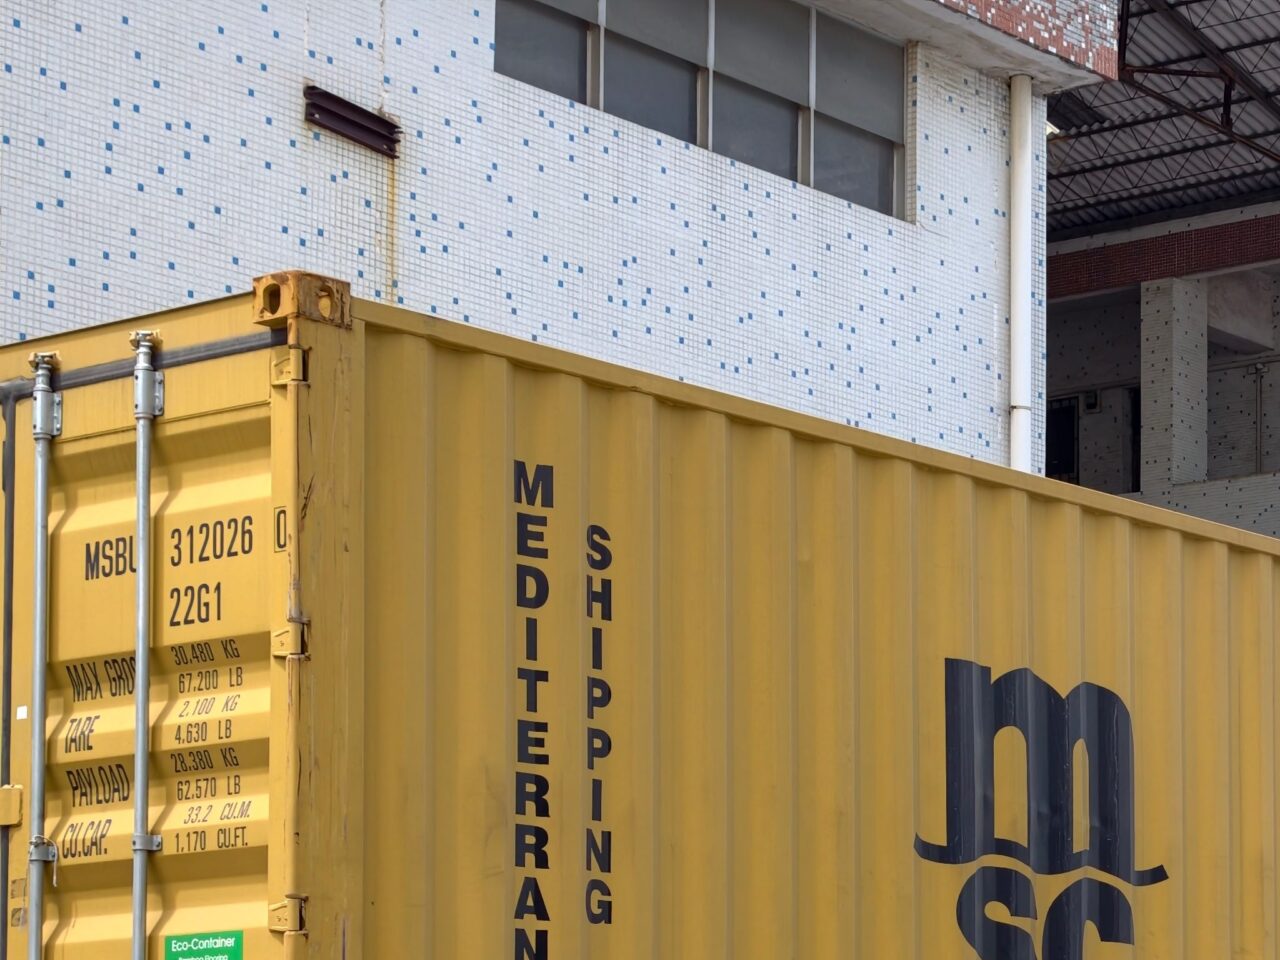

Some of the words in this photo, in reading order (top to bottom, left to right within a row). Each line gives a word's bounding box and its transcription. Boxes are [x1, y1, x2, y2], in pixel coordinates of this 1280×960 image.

[170, 515, 254, 567] 312026
[276, 509, 287, 549] 0
[169, 582, 221, 627] 22G1
[221, 639, 241, 660] KG
[66, 662, 103, 703] MAX
[104, 655, 136, 697] GRO
[229, 666, 243, 687] LB
[221, 694, 240, 713] KG
[65, 715, 100, 754] TARE
[218, 719, 232, 740] LB
[585, 524, 613, 925] SHIPPING
[220, 747, 239, 768] KG
[66, 763, 131, 808] PAYLOAD
[227, 775, 241, 795] LB
[171, 936, 235, 952] Eco-Container
